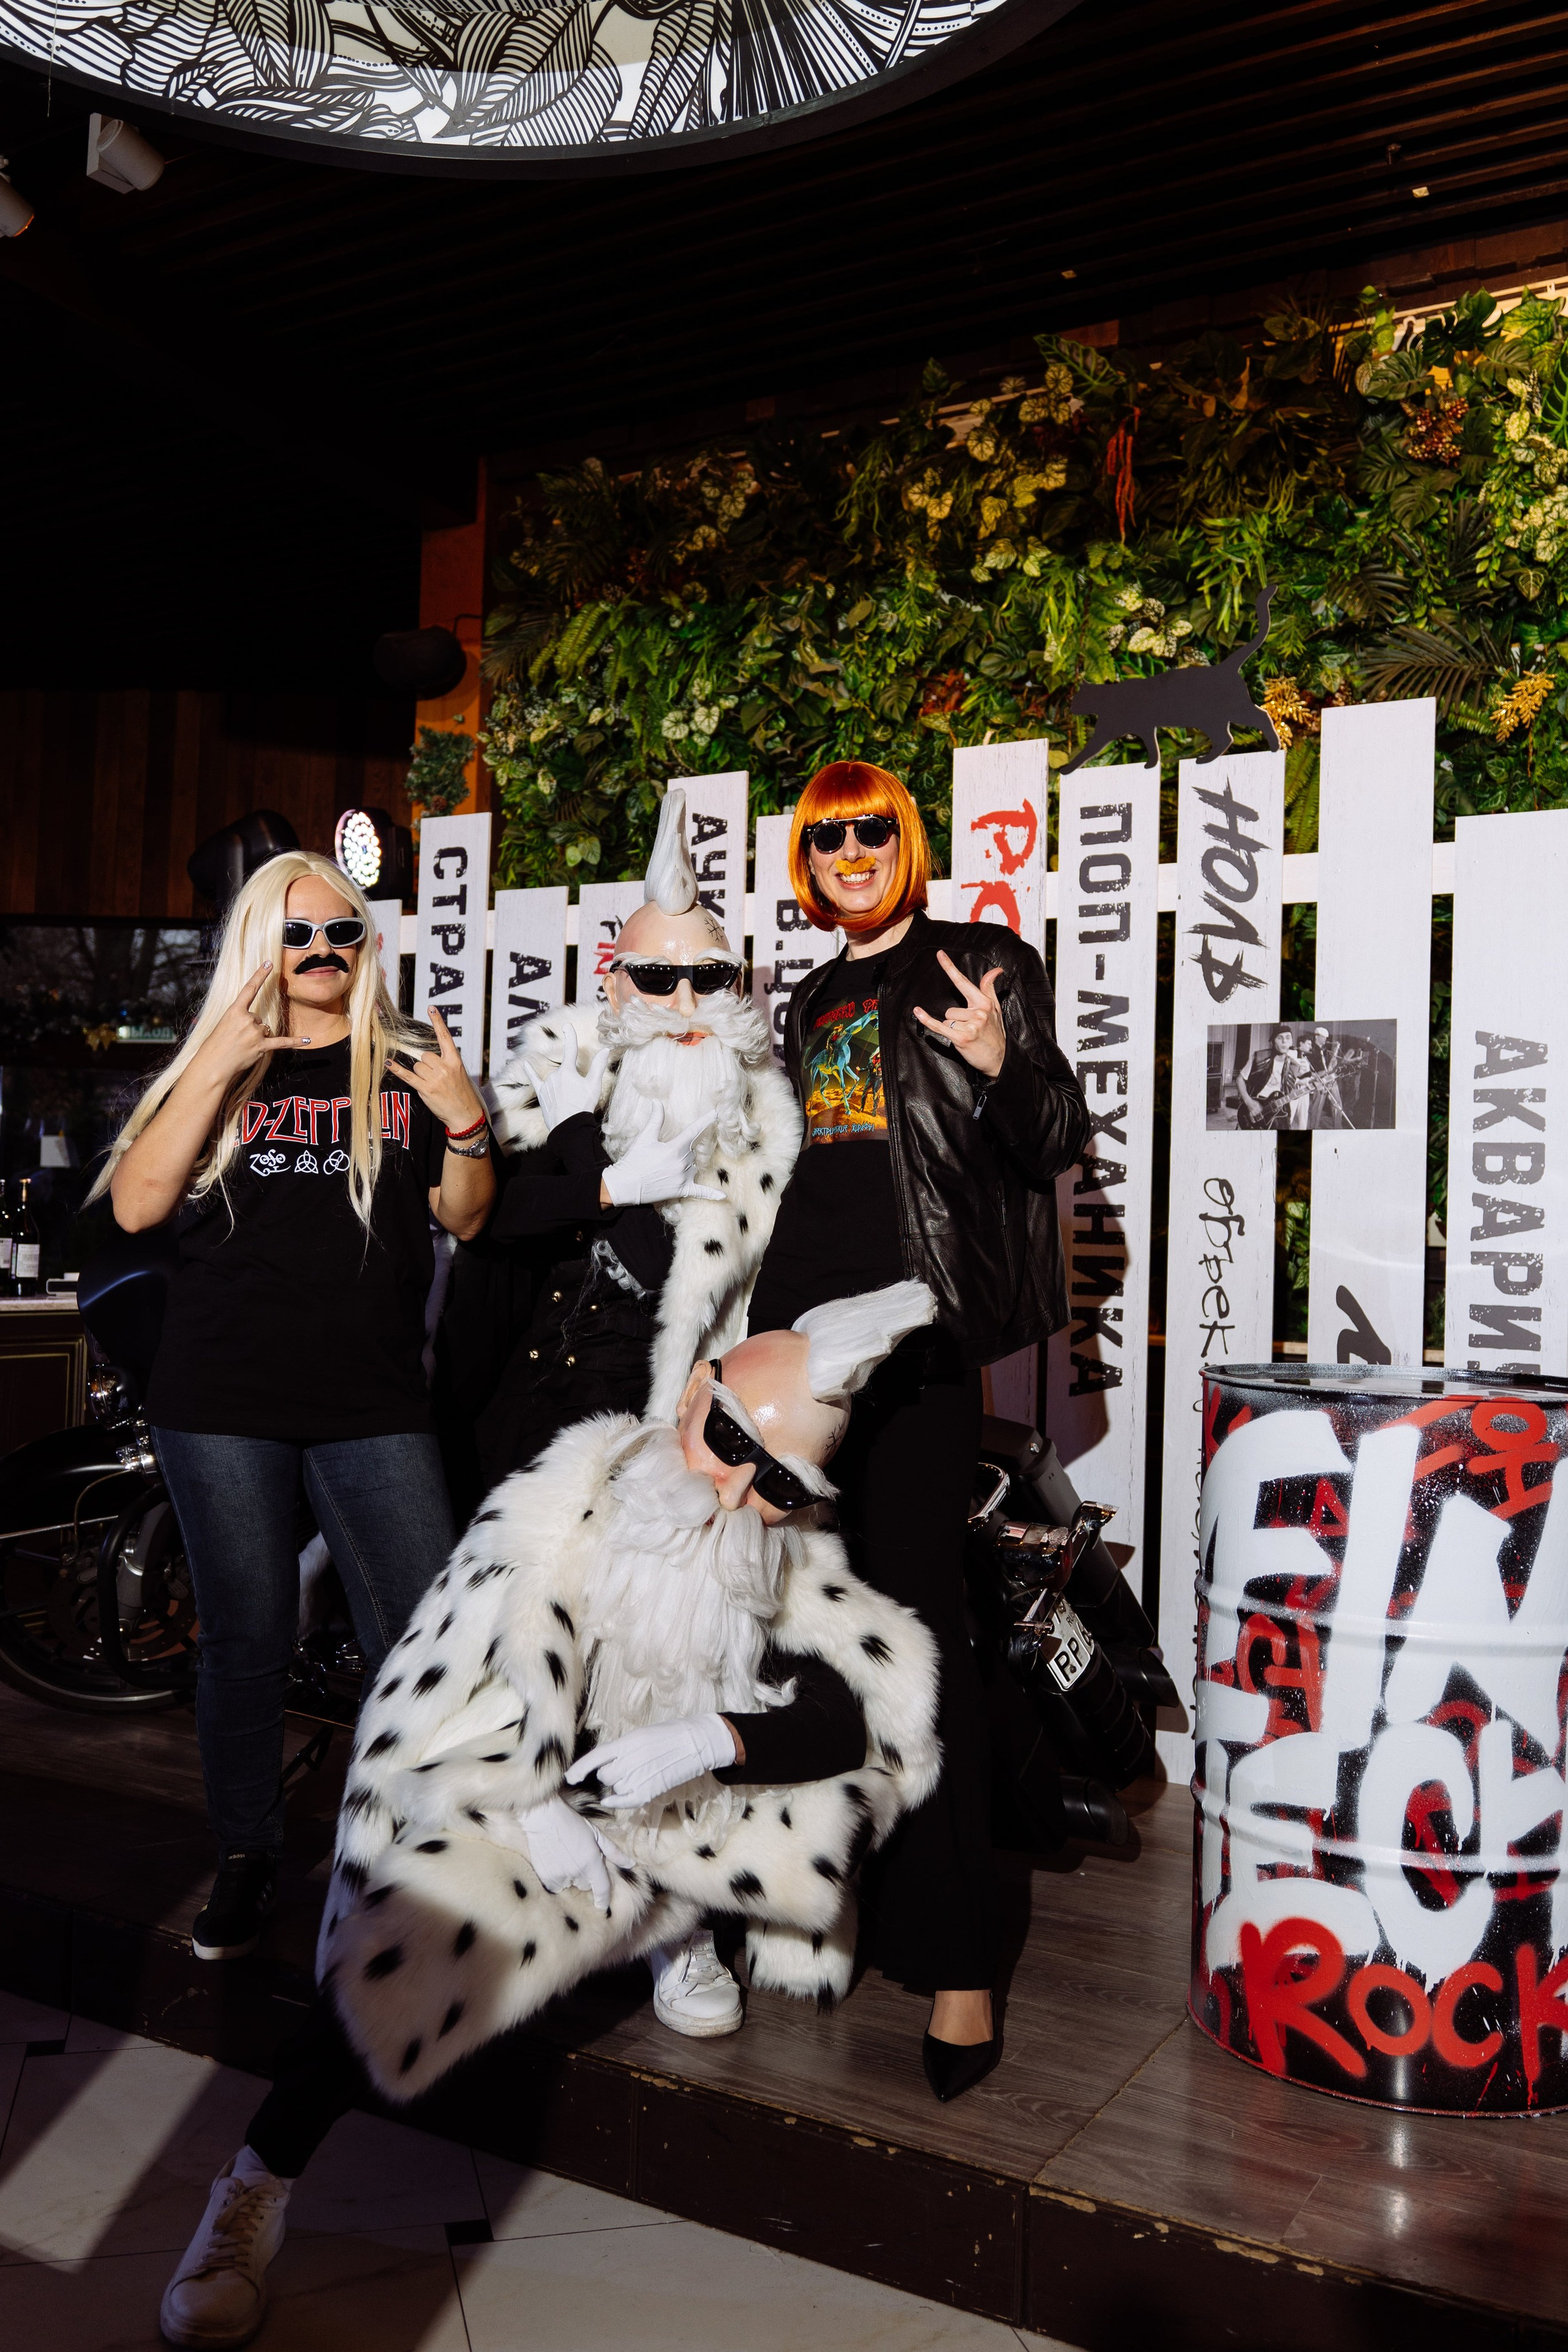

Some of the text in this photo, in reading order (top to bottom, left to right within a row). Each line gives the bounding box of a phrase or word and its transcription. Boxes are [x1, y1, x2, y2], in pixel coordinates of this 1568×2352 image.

[427, 846, 468, 1052] СТРАН
[692, 812, 728, 932] АУК
[507, 951, 552, 1050] АЛ
[1069, 802, 1133, 1396] ПОП-МЕХАНИКА
[1466, 1030, 1548, 1374] АКВАРИ
[1240, 1917, 1568, 2086] ROCK
